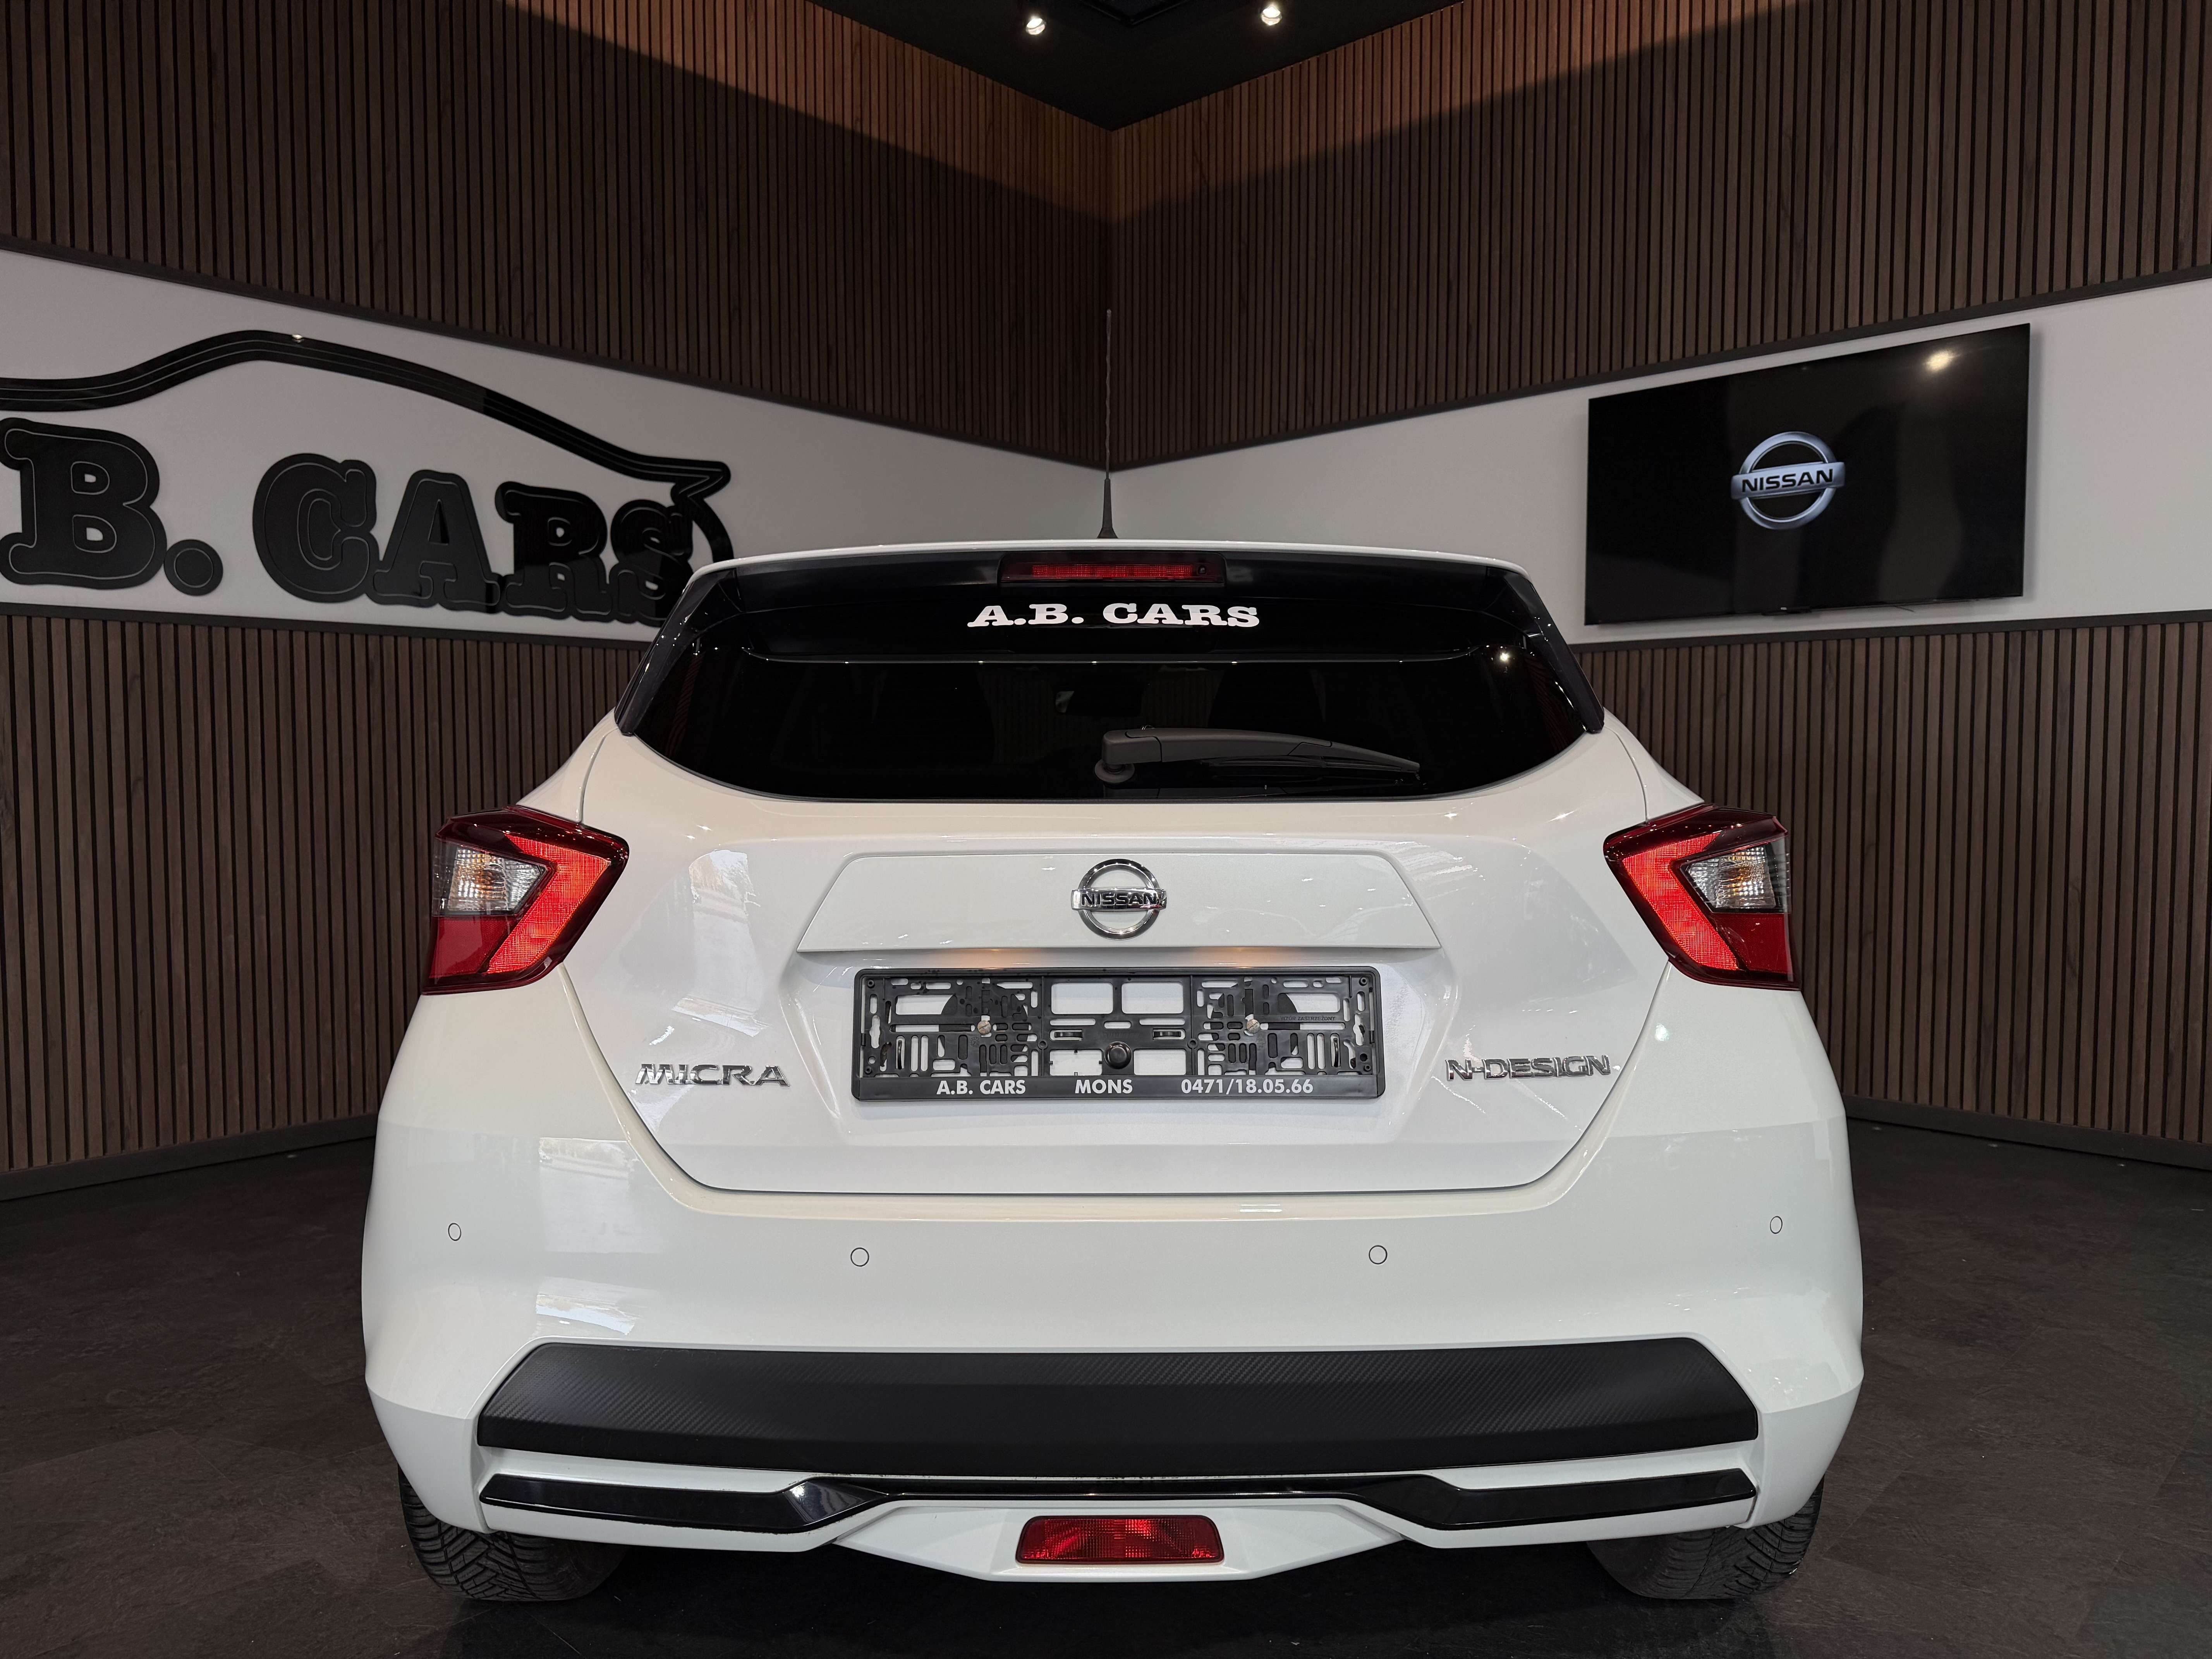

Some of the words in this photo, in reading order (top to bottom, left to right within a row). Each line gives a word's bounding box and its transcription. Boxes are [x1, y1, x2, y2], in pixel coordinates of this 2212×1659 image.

[1742, 469, 1833, 493] NISSAN
[252, 453, 694, 628] CARS
[967, 603, 1084, 627] A.B.
[1103, 603, 1259, 627] CARS
[1081, 892, 1157, 906] NISSAN
[635, 1063, 790, 1087] MICRA
[1445, 1054, 1611, 1081] N-DESIGN
[937, 1079, 974, 1095] A.B.
[979, 1079, 1025, 1095] CARS
[1075, 1079, 1133, 1094] MONS
[1181, 1078, 1314, 1094] 0471/18.05.66
